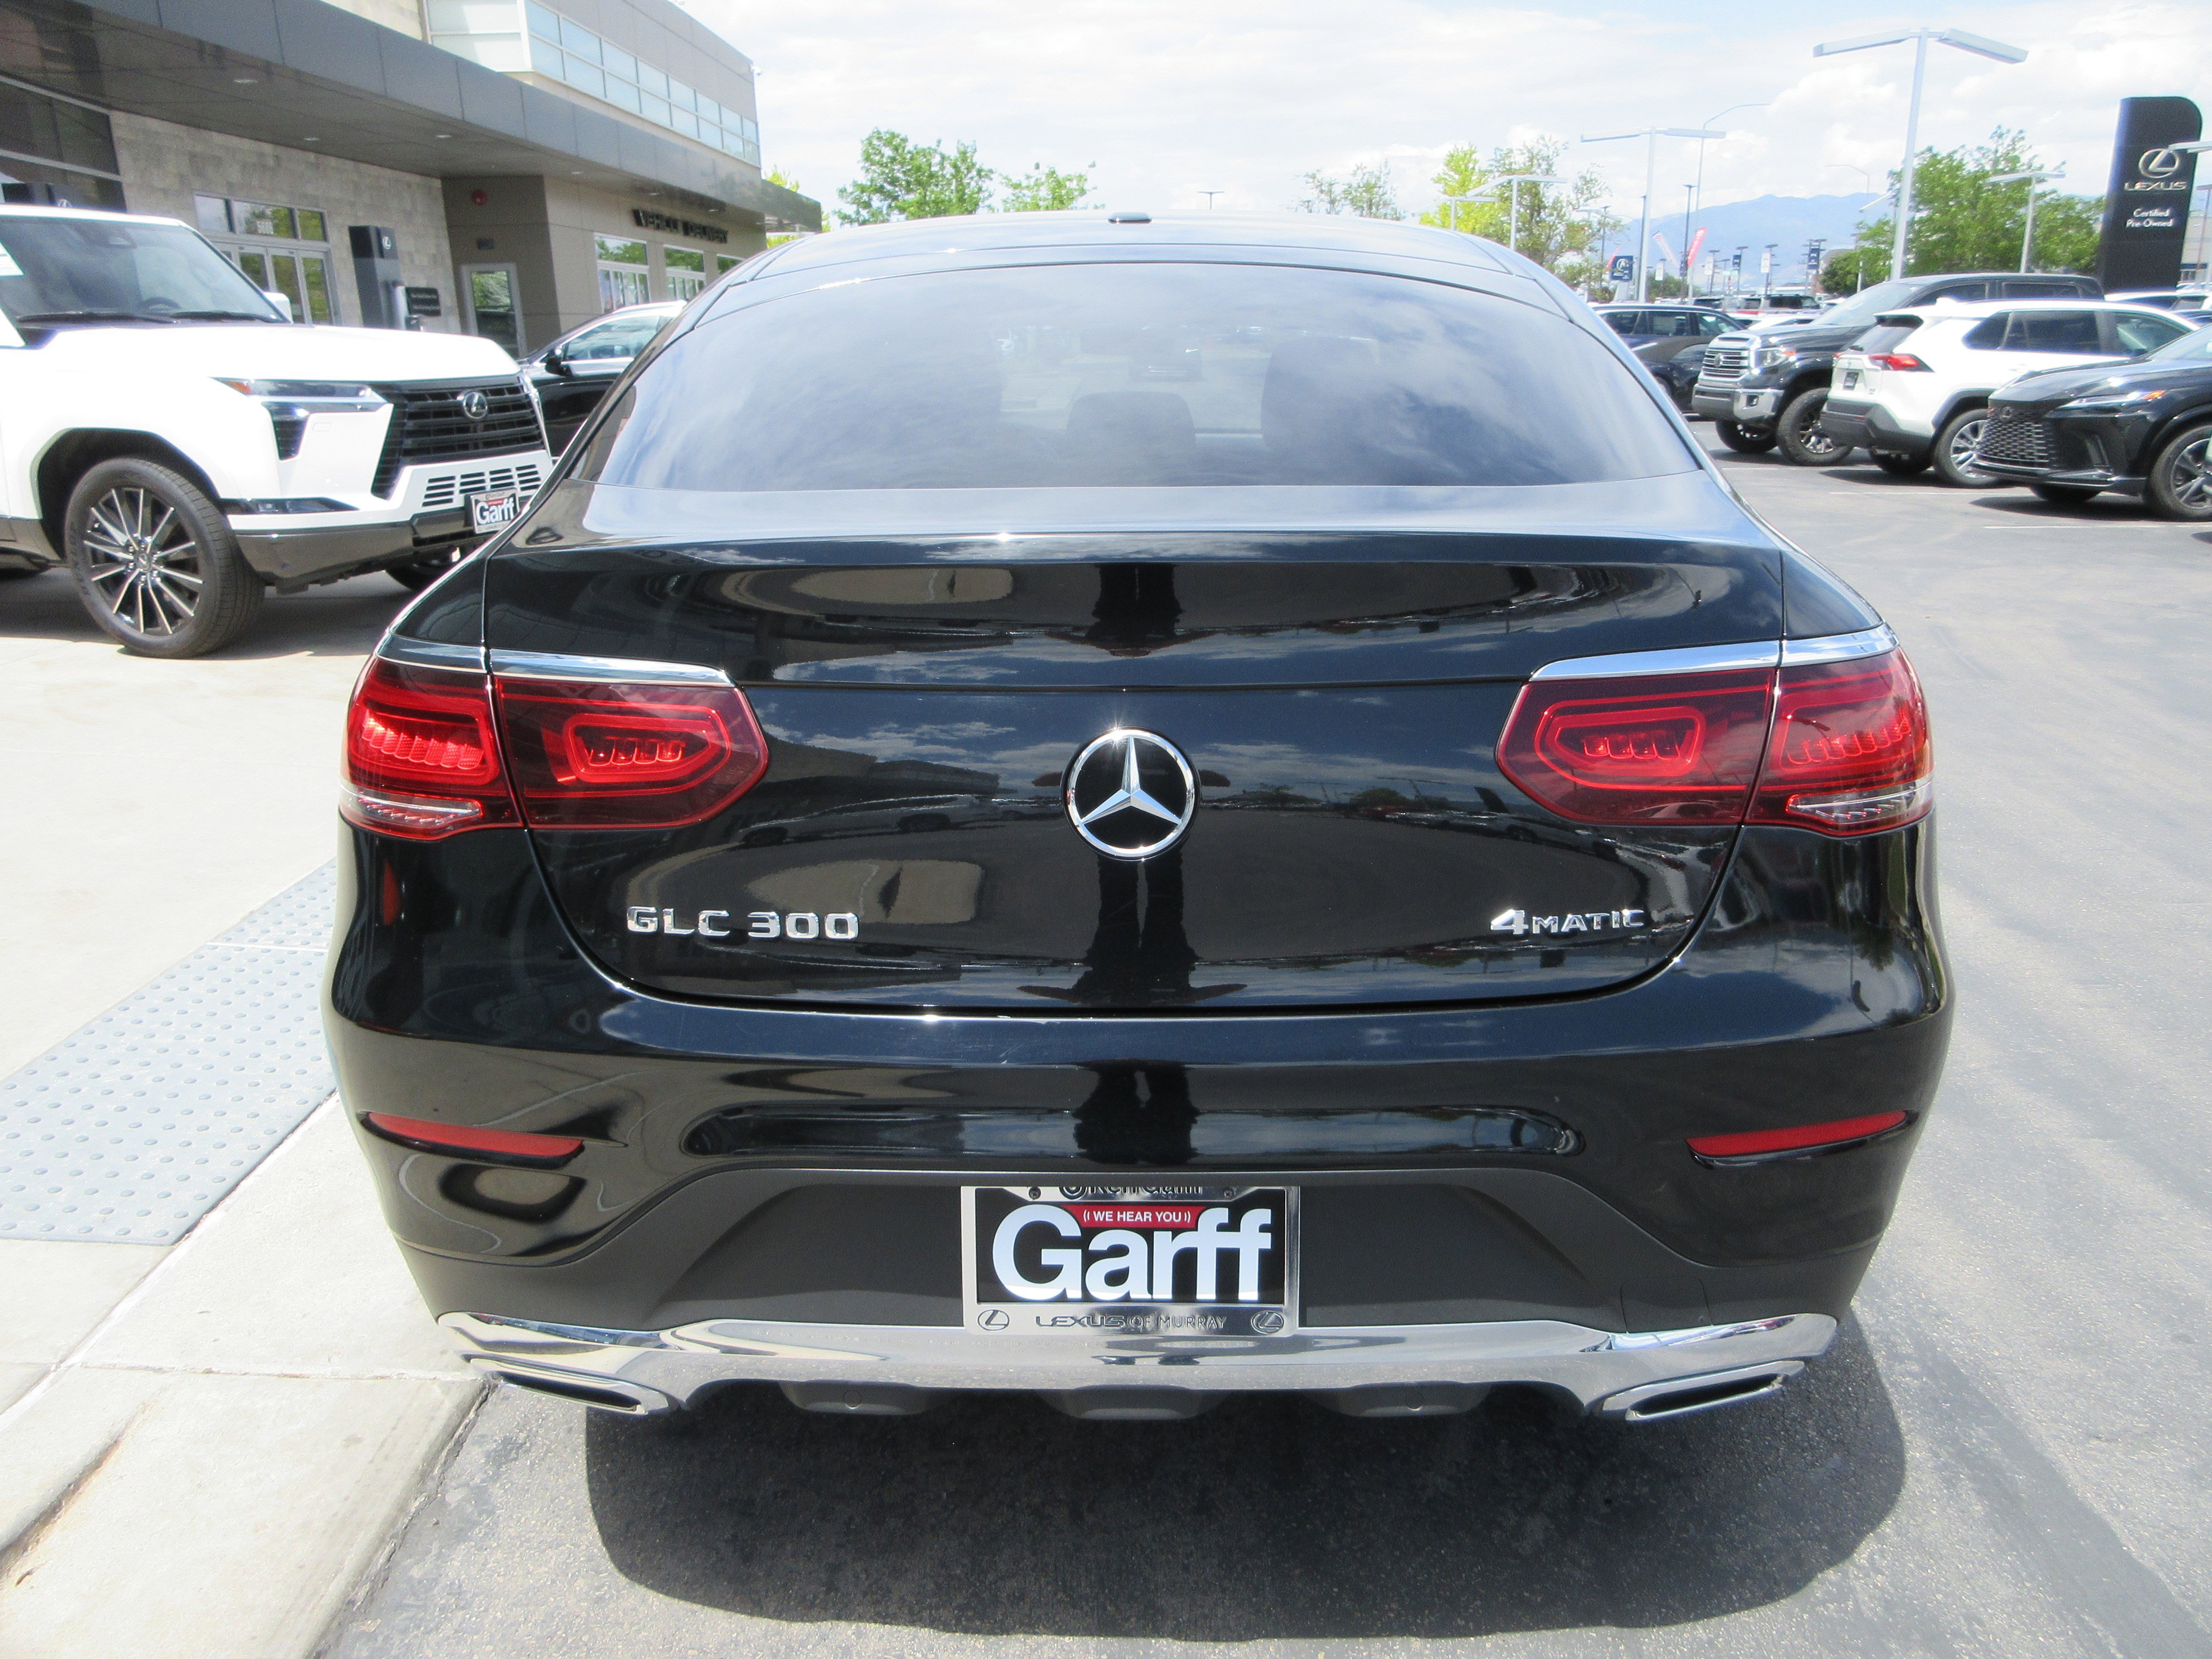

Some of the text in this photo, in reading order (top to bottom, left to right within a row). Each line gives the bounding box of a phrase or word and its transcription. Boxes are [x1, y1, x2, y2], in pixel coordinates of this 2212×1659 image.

[2124, 181, 2187, 191] LEXUS
[2133, 207, 2171, 217] Certified
[2125, 218, 2174, 228] Pre-Owned
[476, 497, 514, 524] Garff
[626, 906, 859, 939] GLC 300
[1490, 909, 1645, 935] 4MATIC
[1093, 1211, 1182, 1222] WE HEAR YOU
[992, 1204, 1272, 1301] Garff
[1036, 1315, 1227, 1328] LEXUS OF MURRAY
